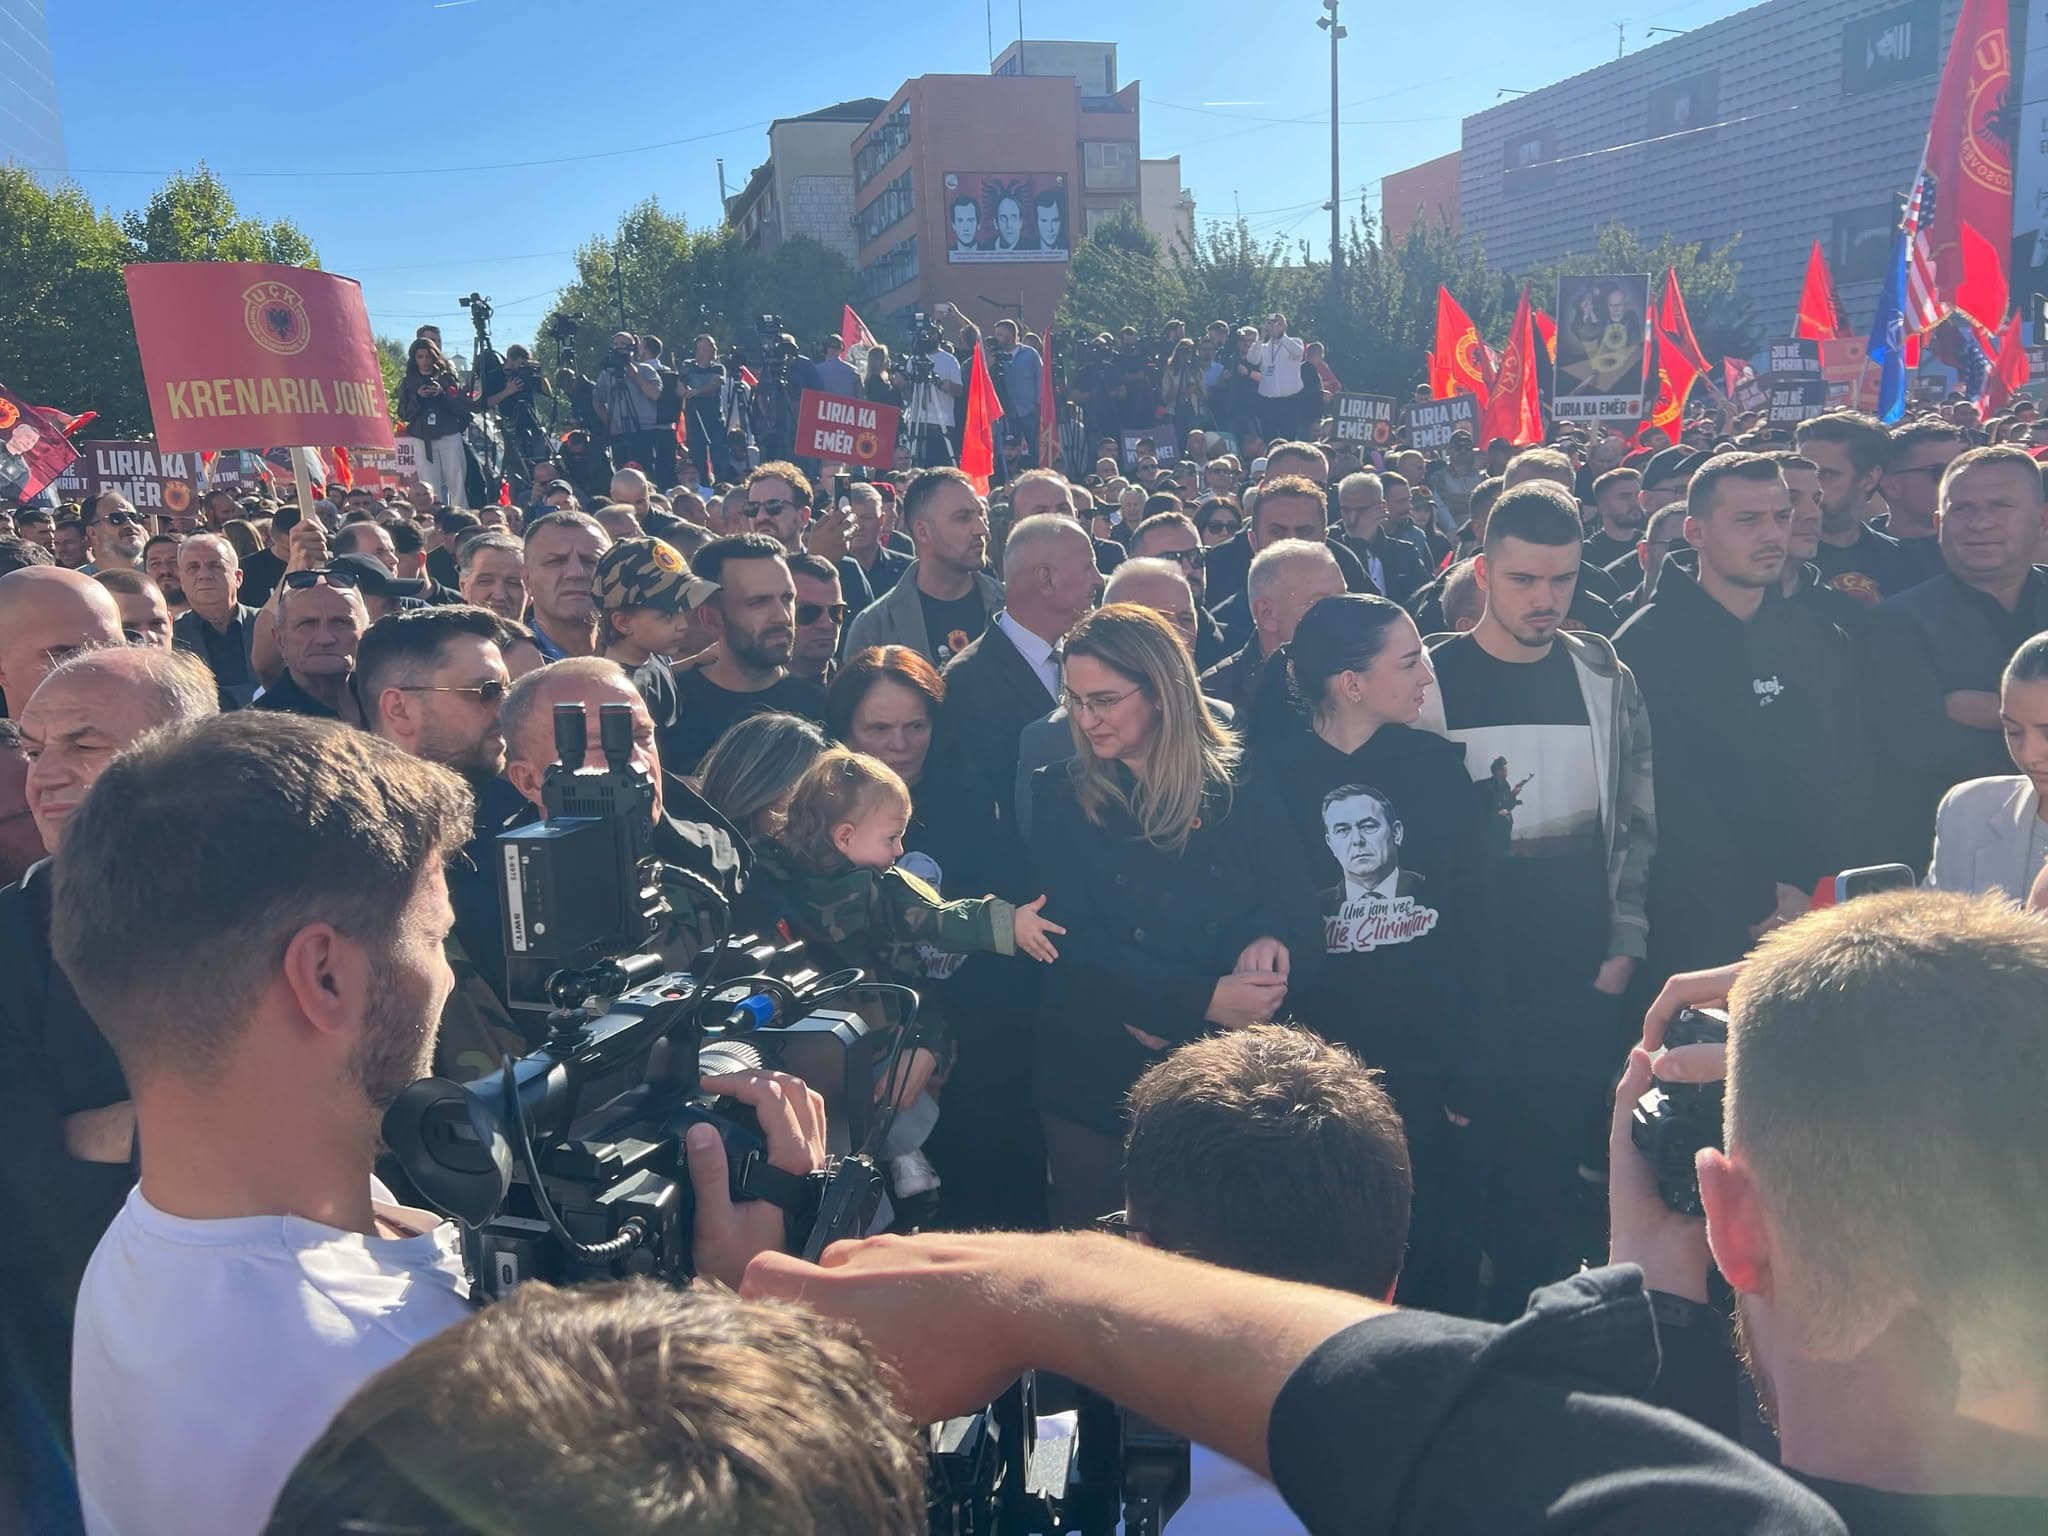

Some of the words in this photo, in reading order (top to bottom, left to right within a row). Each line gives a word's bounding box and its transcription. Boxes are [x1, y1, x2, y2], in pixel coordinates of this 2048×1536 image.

[166, 377, 330, 420] KRENARIA
[332, 377, 383, 419] JONË
[1339, 398, 1374, 419] LIRIA
[1375, 402, 1391, 421] KA
[1555, 401, 1581, 417] LIRIA
[1583, 401, 1598, 417] KA
[1600, 398, 1627, 416] EMËR
[817, 399, 855, 427] LIRIA
[857, 407, 877, 430] KA
[1410, 404, 1450, 427] LIRIA
[1450, 400, 1473, 421] KA
[813, 429, 854, 455] EMËR
[1336, 418, 1373, 441] EMËR
[1411, 424, 1450, 449] EMËR
[96, 450, 158, 478] LIRIA
[160, 453, 189, 480] KA
